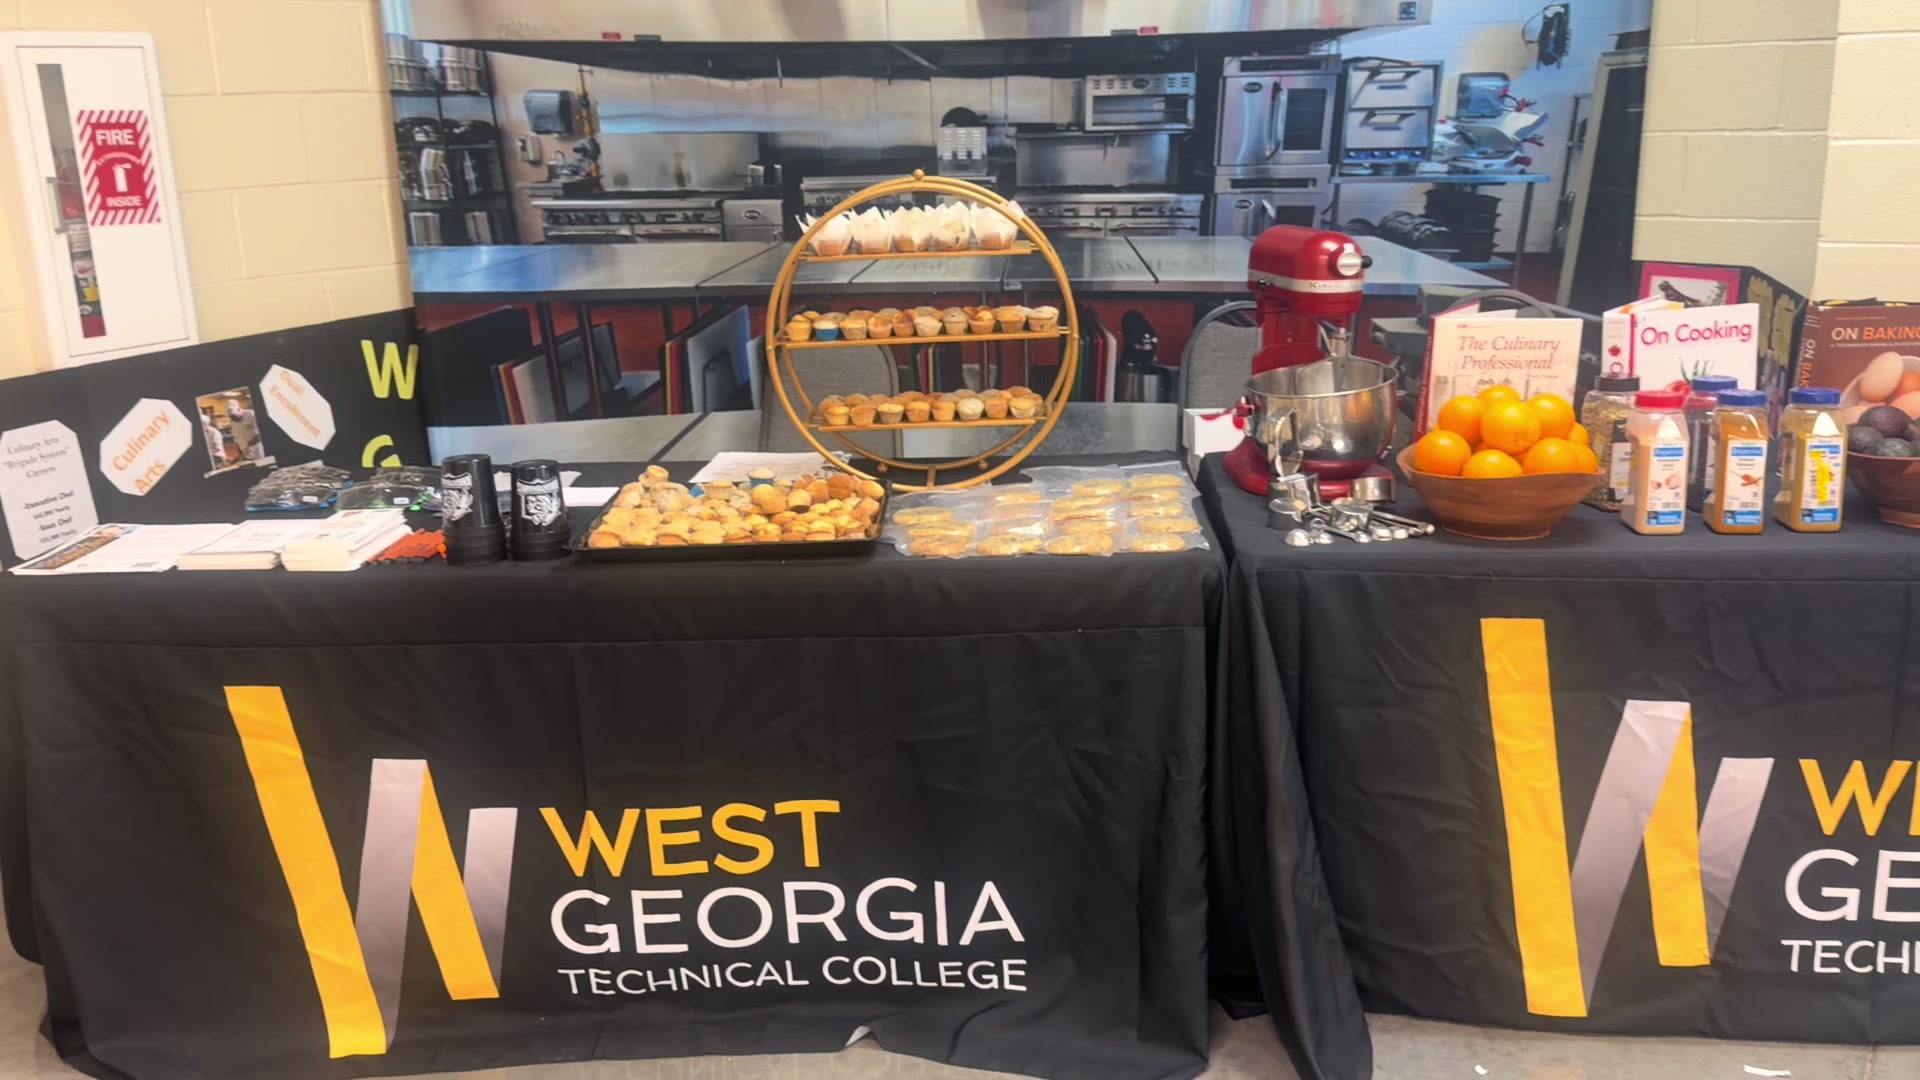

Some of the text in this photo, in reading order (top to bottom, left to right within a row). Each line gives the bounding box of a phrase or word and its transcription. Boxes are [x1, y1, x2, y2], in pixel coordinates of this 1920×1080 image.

[95, 129, 135, 146] FIRE
[106, 195, 142, 208] INSIDE
[1457, 335, 1561, 353] The Culinary
[1641, 327, 1669, 345] On
[1675, 320, 1753, 342] Cooking
[1831, 327, 1859, 340] ON
[361, 340, 419, 400] W
[1461, 354, 1554, 374] Professional
[1799, 338, 1816, 388] ON BAK
[269, 385, 322, 438] Enrollment
[113, 411, 171, 472] Culinary
[134, 460, 166, 494] Arts
[1799, 759, 1920, 836] W
[539, 799, 841, 877] WEST
[550, 877, 1025, 954] GEORGIA
[1781, 939, 1920, 973] TECH
[557, 956, 1028, 996] TECHNICAL COLLEGE
